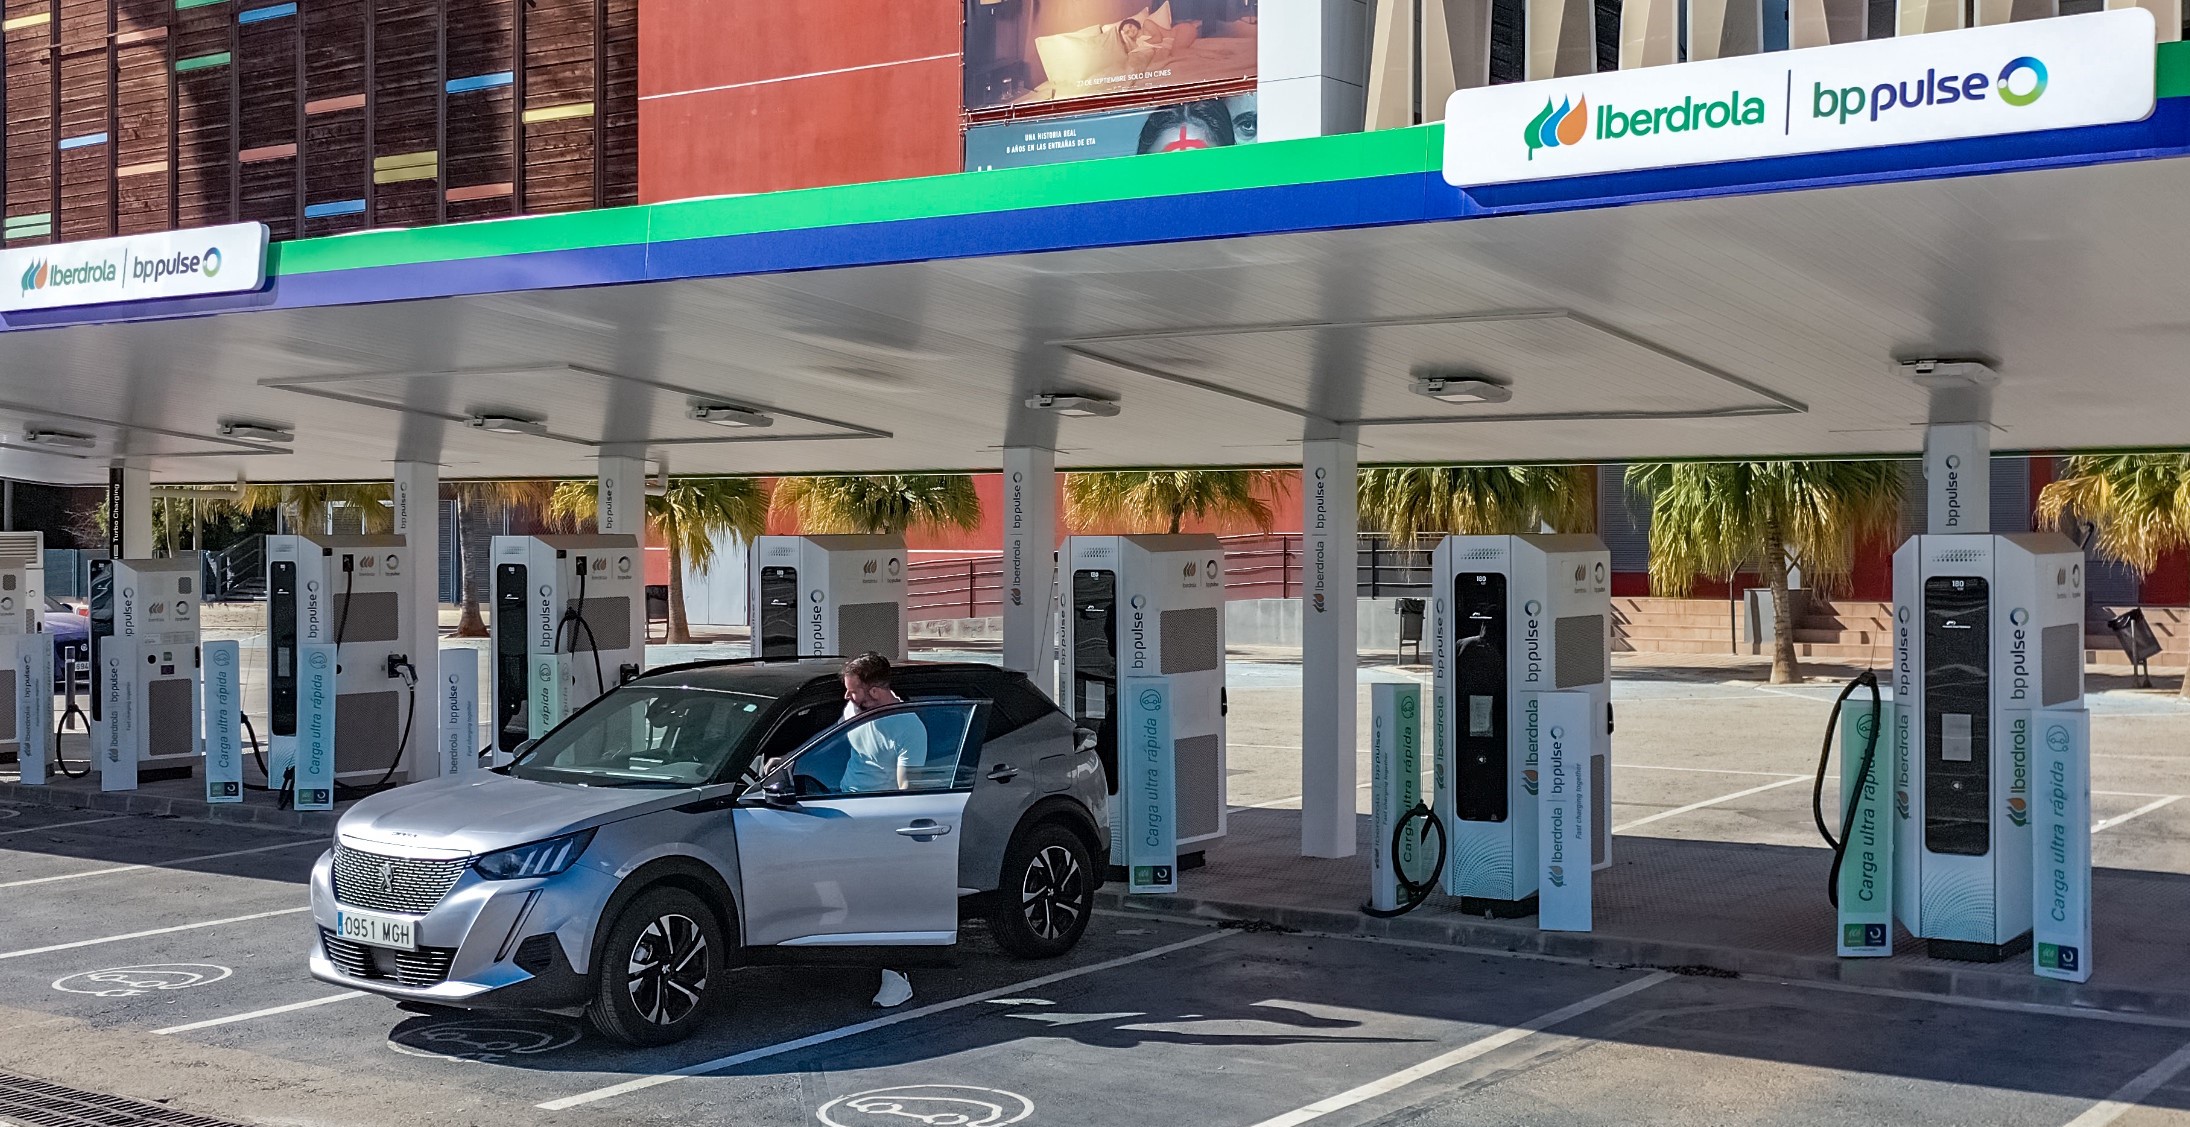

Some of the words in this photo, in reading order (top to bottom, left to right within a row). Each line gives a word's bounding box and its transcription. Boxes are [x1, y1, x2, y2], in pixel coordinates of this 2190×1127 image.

[1128, 72, 1143, 80] SOLO
[1153, 69, 1171, 77] CINES
[1596, 89, 1765, 141] Iberdrola
[1011, 144, 1026, 153] AÑOS
[1027, 144, 1035, 152] EN
[1036, 143, 1046, 151] LAS
[1048, 139, 1075, 149] ENTRAÑAS
[1024, 133, 1036, 142] UNA
[1037, 131, 1061, 140] HISTORIA
[1063, 129, 1077, 137] REAL
[50, 259, 116, 287] Iberdrola
[112, 484, 120, 519] Charging
[1012, 539, 1021, 586] Iberdrola
[1315, 541, 1324, 591] Iberdrola
[216, 671, 229, 705] rápida
[310, 674, 324, 710] rápida
[541, 687, 551, 726] rápida
[109, 711, 119, 747] Iberdrola
[217, 709, 228, 734] ultra
[310, 713, 322, 738] ultra
[1143, 718, 1160, 763] rápida
[1436, 695, 1444, 761] Iberdrola
[1525, 699, 1539, 766] Iberdrola
[218, 736, 231, 768] Carga
[309, 741, 324, 775] Carga
[449, 733, 458, 774] Iberdrola
[1400, 726, 1414, 774] rápida
[1899, 715, 1909, 787] Iberdrola
[2010, 719, 2026, 794] Iberdrola
[1144, 769, 1159, 801] ultra
[2049, 760, 2067, 817] rápida
[1145, 805, 1162, 847] Carga
[1575, 793, 1583, 824] charging
[1859, 808, 1875, 846] ultra
[1551, 808, 1563, 863] Iberdrola
[2049, 824, 2065, 864] ultra
[1858, 852, 1878, 902] Carga
[2050, 869, 2069, 922] Carga
[345, 916, 375, 940] 0951
[382, 922, 409, 945] MGH
